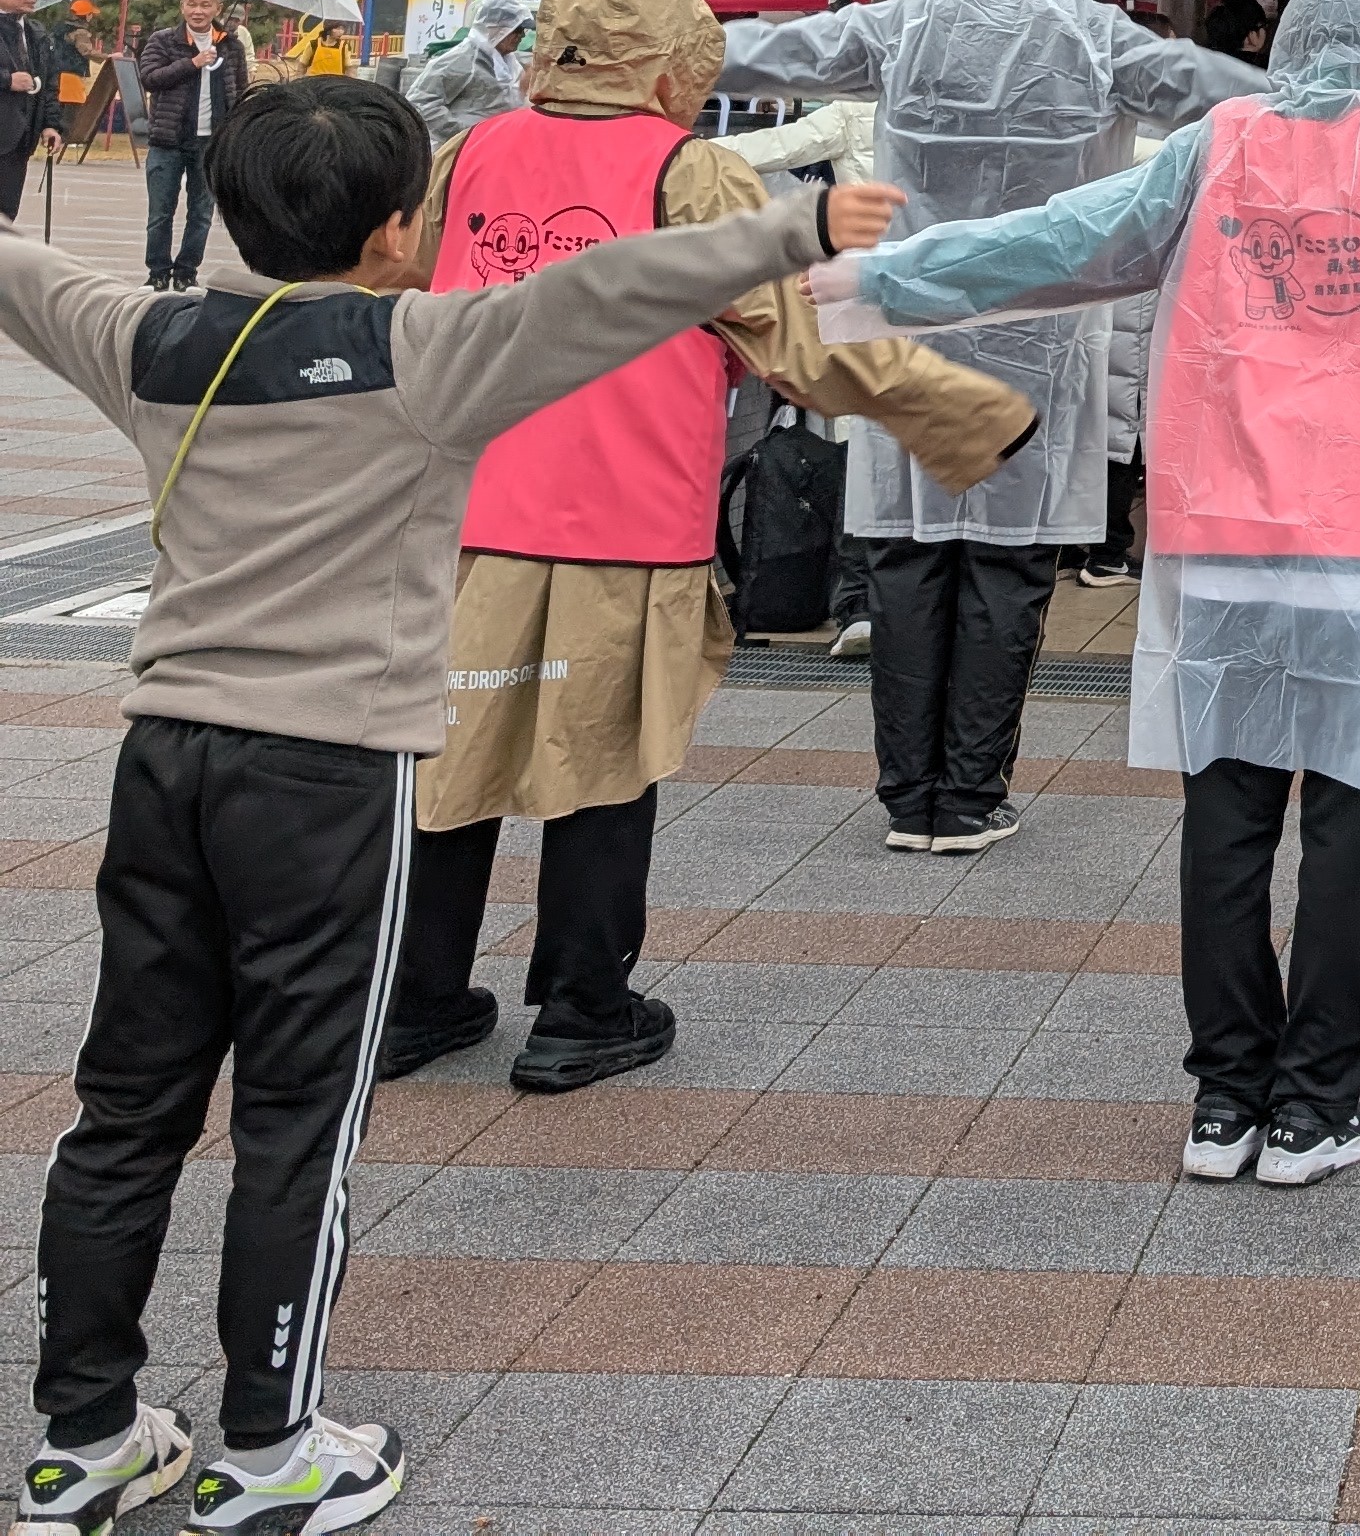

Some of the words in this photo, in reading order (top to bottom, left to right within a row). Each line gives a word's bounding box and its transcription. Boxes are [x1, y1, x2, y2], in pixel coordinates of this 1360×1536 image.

[313, 358, 332, 368] THE
[299, 367, 332, 377] NORTH
[310, 374, 334, 384] FACE
[468, 667, 519, 690] DROPS
[538, 659, 568, 680] AIN
[1198, 1123, 1222, 1135] AIR
